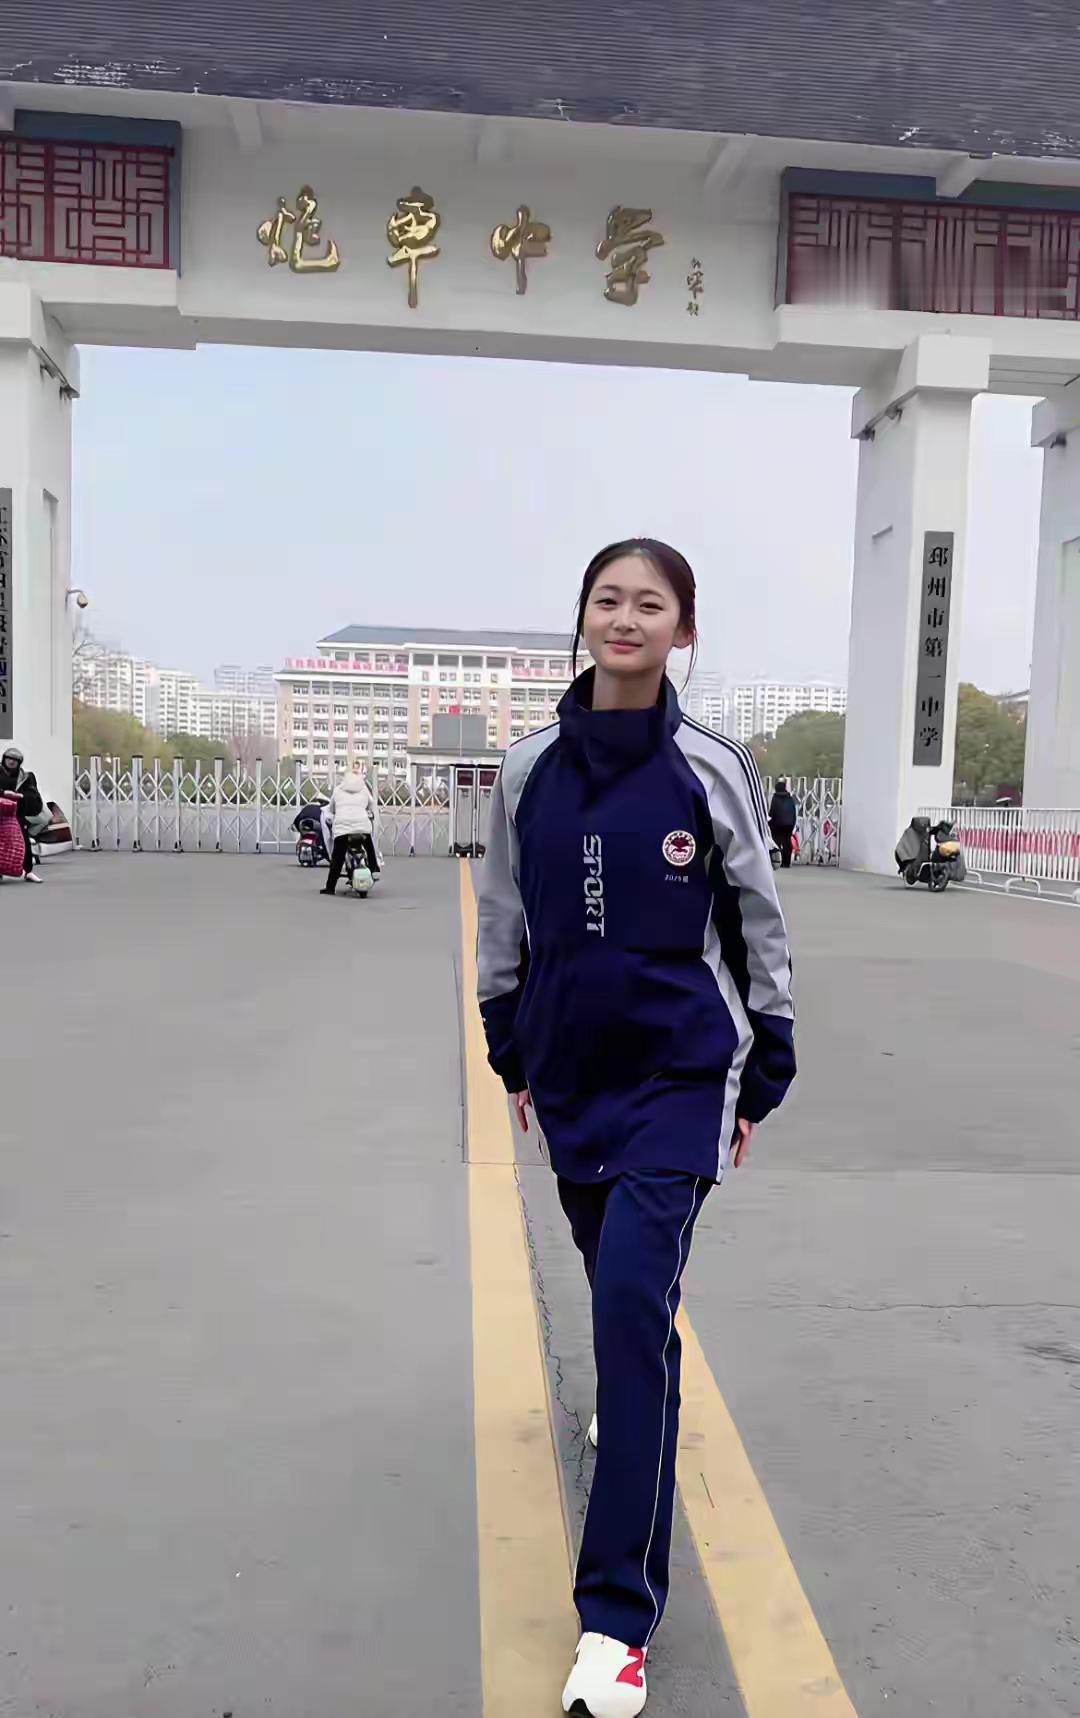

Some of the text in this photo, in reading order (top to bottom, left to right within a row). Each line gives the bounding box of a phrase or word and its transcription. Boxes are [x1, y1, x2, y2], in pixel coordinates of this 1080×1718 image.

[919, 547, 949, 747] 邳州市第一中学
[584, 834, 605, 937] SPORT
